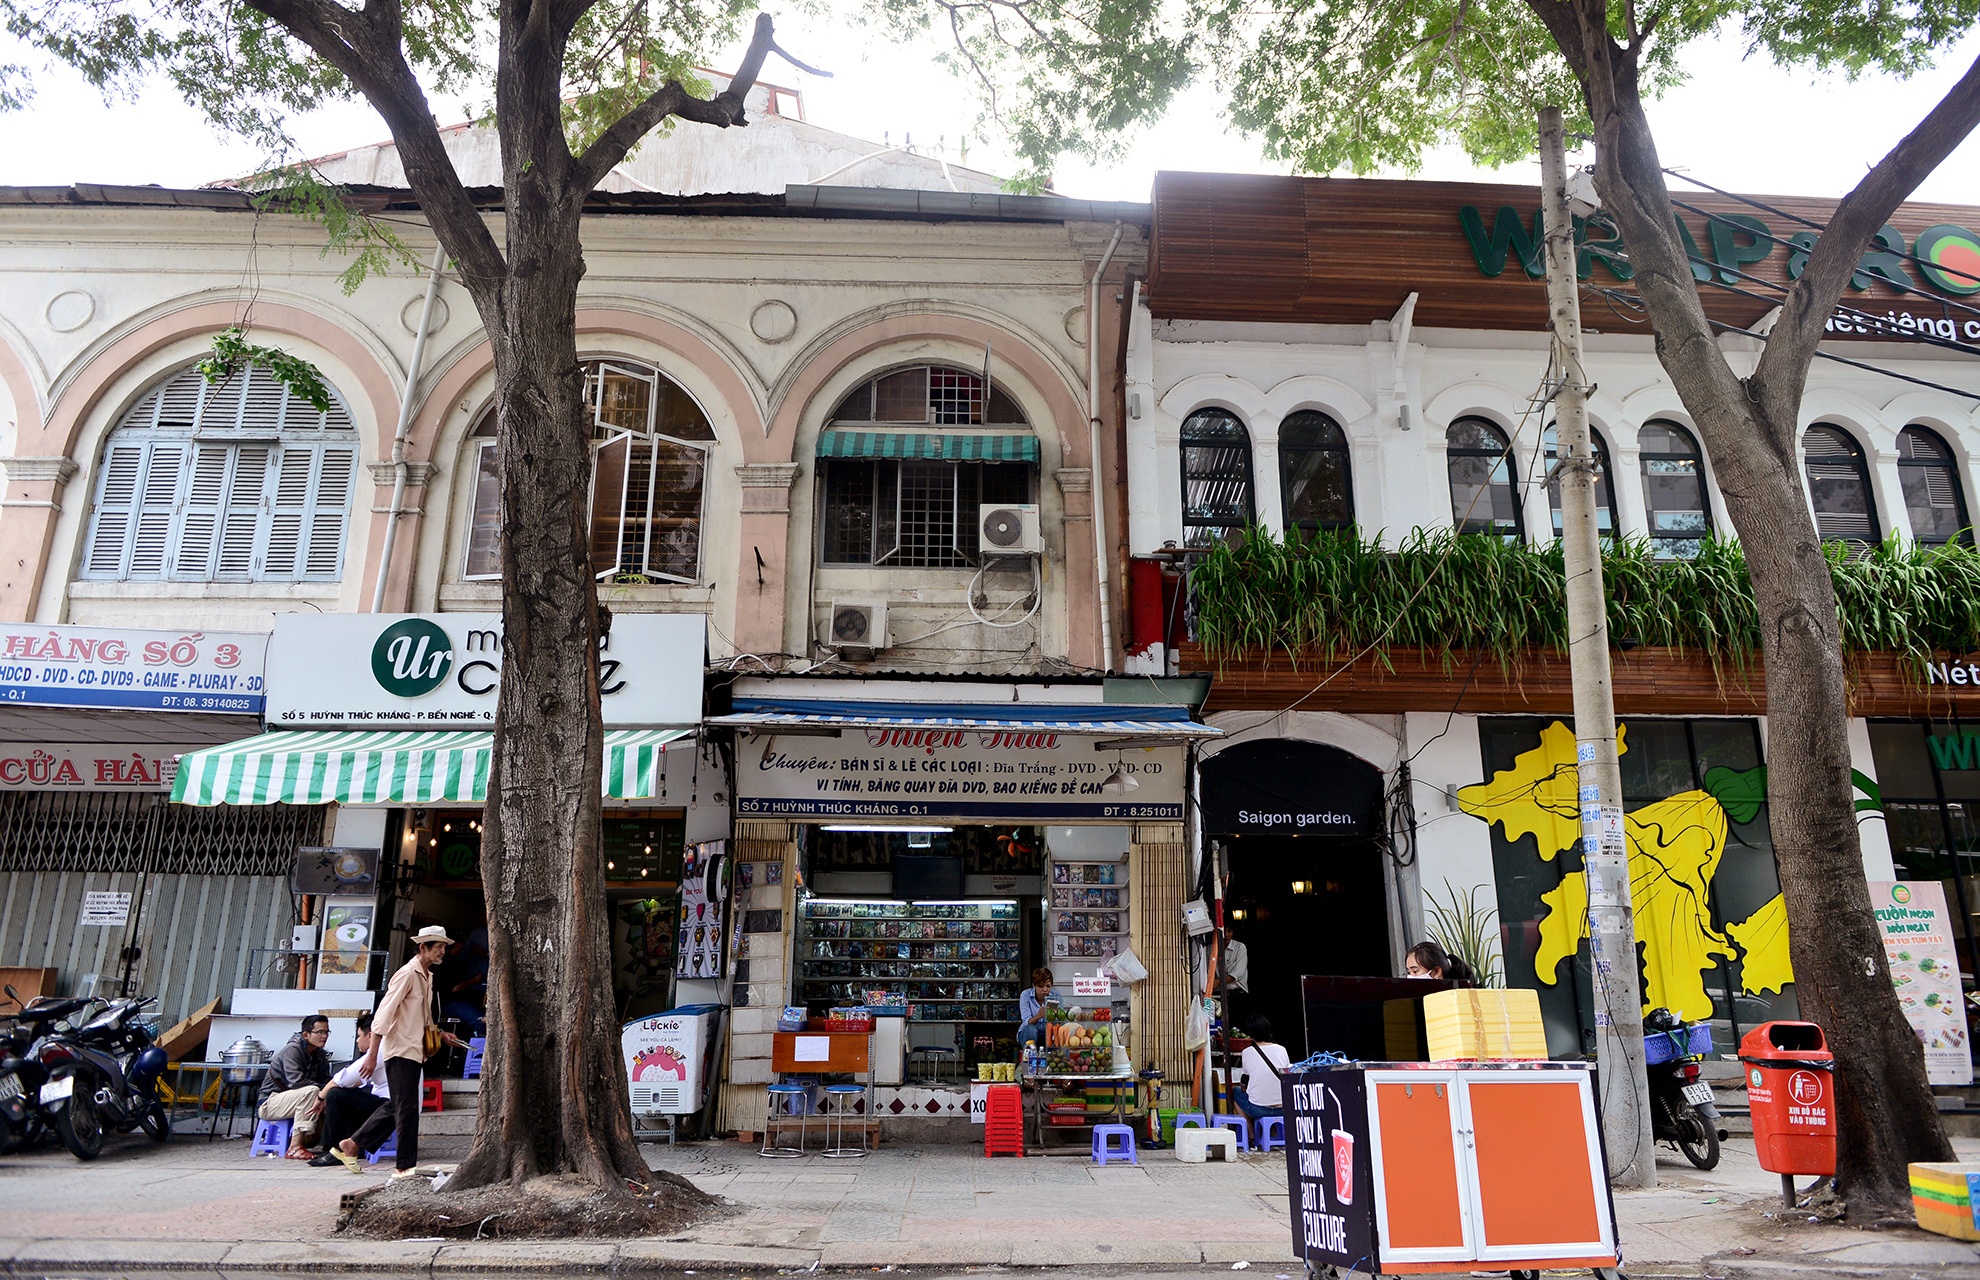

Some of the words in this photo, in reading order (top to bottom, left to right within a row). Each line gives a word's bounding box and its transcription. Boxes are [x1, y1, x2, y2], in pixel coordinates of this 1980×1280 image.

[1, 631, 129, 665] HÀNG
[143, 632, 204, 667] SỐ
[214, 644, 241, 668] 3
[387, 635, 452, 680] Ur
[42, 668, 68, 683] DVD
[101, 670, 134, 686] DVD9
[143, 672, 179, 687] GAME
[188, 674, 237, 690] PLURAY
[247, 676, 262, 691] 3D
[162, 696, 181, 706] ĐT:
[184, 698, 198, 707] 08.
[201, 698, 250, 709] 39140825
[282, 709, 296, 720] SỐ
[299, 712, 305, 720] 5
[311, 709, 344, 720] HUỲNH
[348, 709, 373, 720] THÚC
[377, 709, 410, 720] KHÁNG
[417, 712, 426, 720] P.
[428, 708, 447, 720] BẾN
[450, 710, 476, 720] NGHÉ
[759, 752, 836, 773] Chuyên:
[841, 756, 869, 772] BÁN
[888, 760, 898, 771] &
[922, 758, 946, 773] CÁC
[951, 761, 981, 775] LOẠI
[993, 762, 1014, 773] Đĩa
[1018, 761, 1057, 776] Trắng
[1068, 763, 1096, 774] DVD
[1144, 763, 1162, 774] CD
[1926, 735, 1980, 770] W
[0, 749, 84, 785] CỬA
[817, 779, 829, 791] VI
[833, 776, 864, 793] TÍNH,
[867, 778, 900, 792] BĂNG
[904, 781, 936, 793] QUAY
[938, 778, 958, 793] ĐĨA
[962, 782, 989, 795] DVD,
[993, 782, 1017, 794] BAO
[1020, 778, 1057, 794] KIẾNG
[1061, 778, 1078, 794] ĐỀ
[1080, 782, 1104, 794] CAN
[742, 799, 759, 812] SỐ
[763, 802, 770, 812] 7
[772, 801, 815, 812] HUỲNH
[818, 802, 852, 814] THÚC
[855, 803, 899, 815] KHÁNG
[910, 806, 928, 815] Q.1
[1104, 807, 1120, 816] ĐT
[1130, 807, 1179, 817] 8.251011
[1238, 811, 1292, 827] Saigon
[1297, 811, 1356, 827] garden.
[1309, 1083, 1325, 1110] NOT
[1789, 1106, 1800, 1115] XIN
[1812, 1106, 1826, 1116] RÁC
[1296, 1116, 1314, 1144] ONLY
[1317, 1116, 1324, 1144] A
[1298, 1148, 1324, 1178] DRINK
[1301, 1182, 1317, 1211] BUT
[1320, 1184, 1326, 1212] A
[1303, 1210, 1348, 1254] CULTURE
